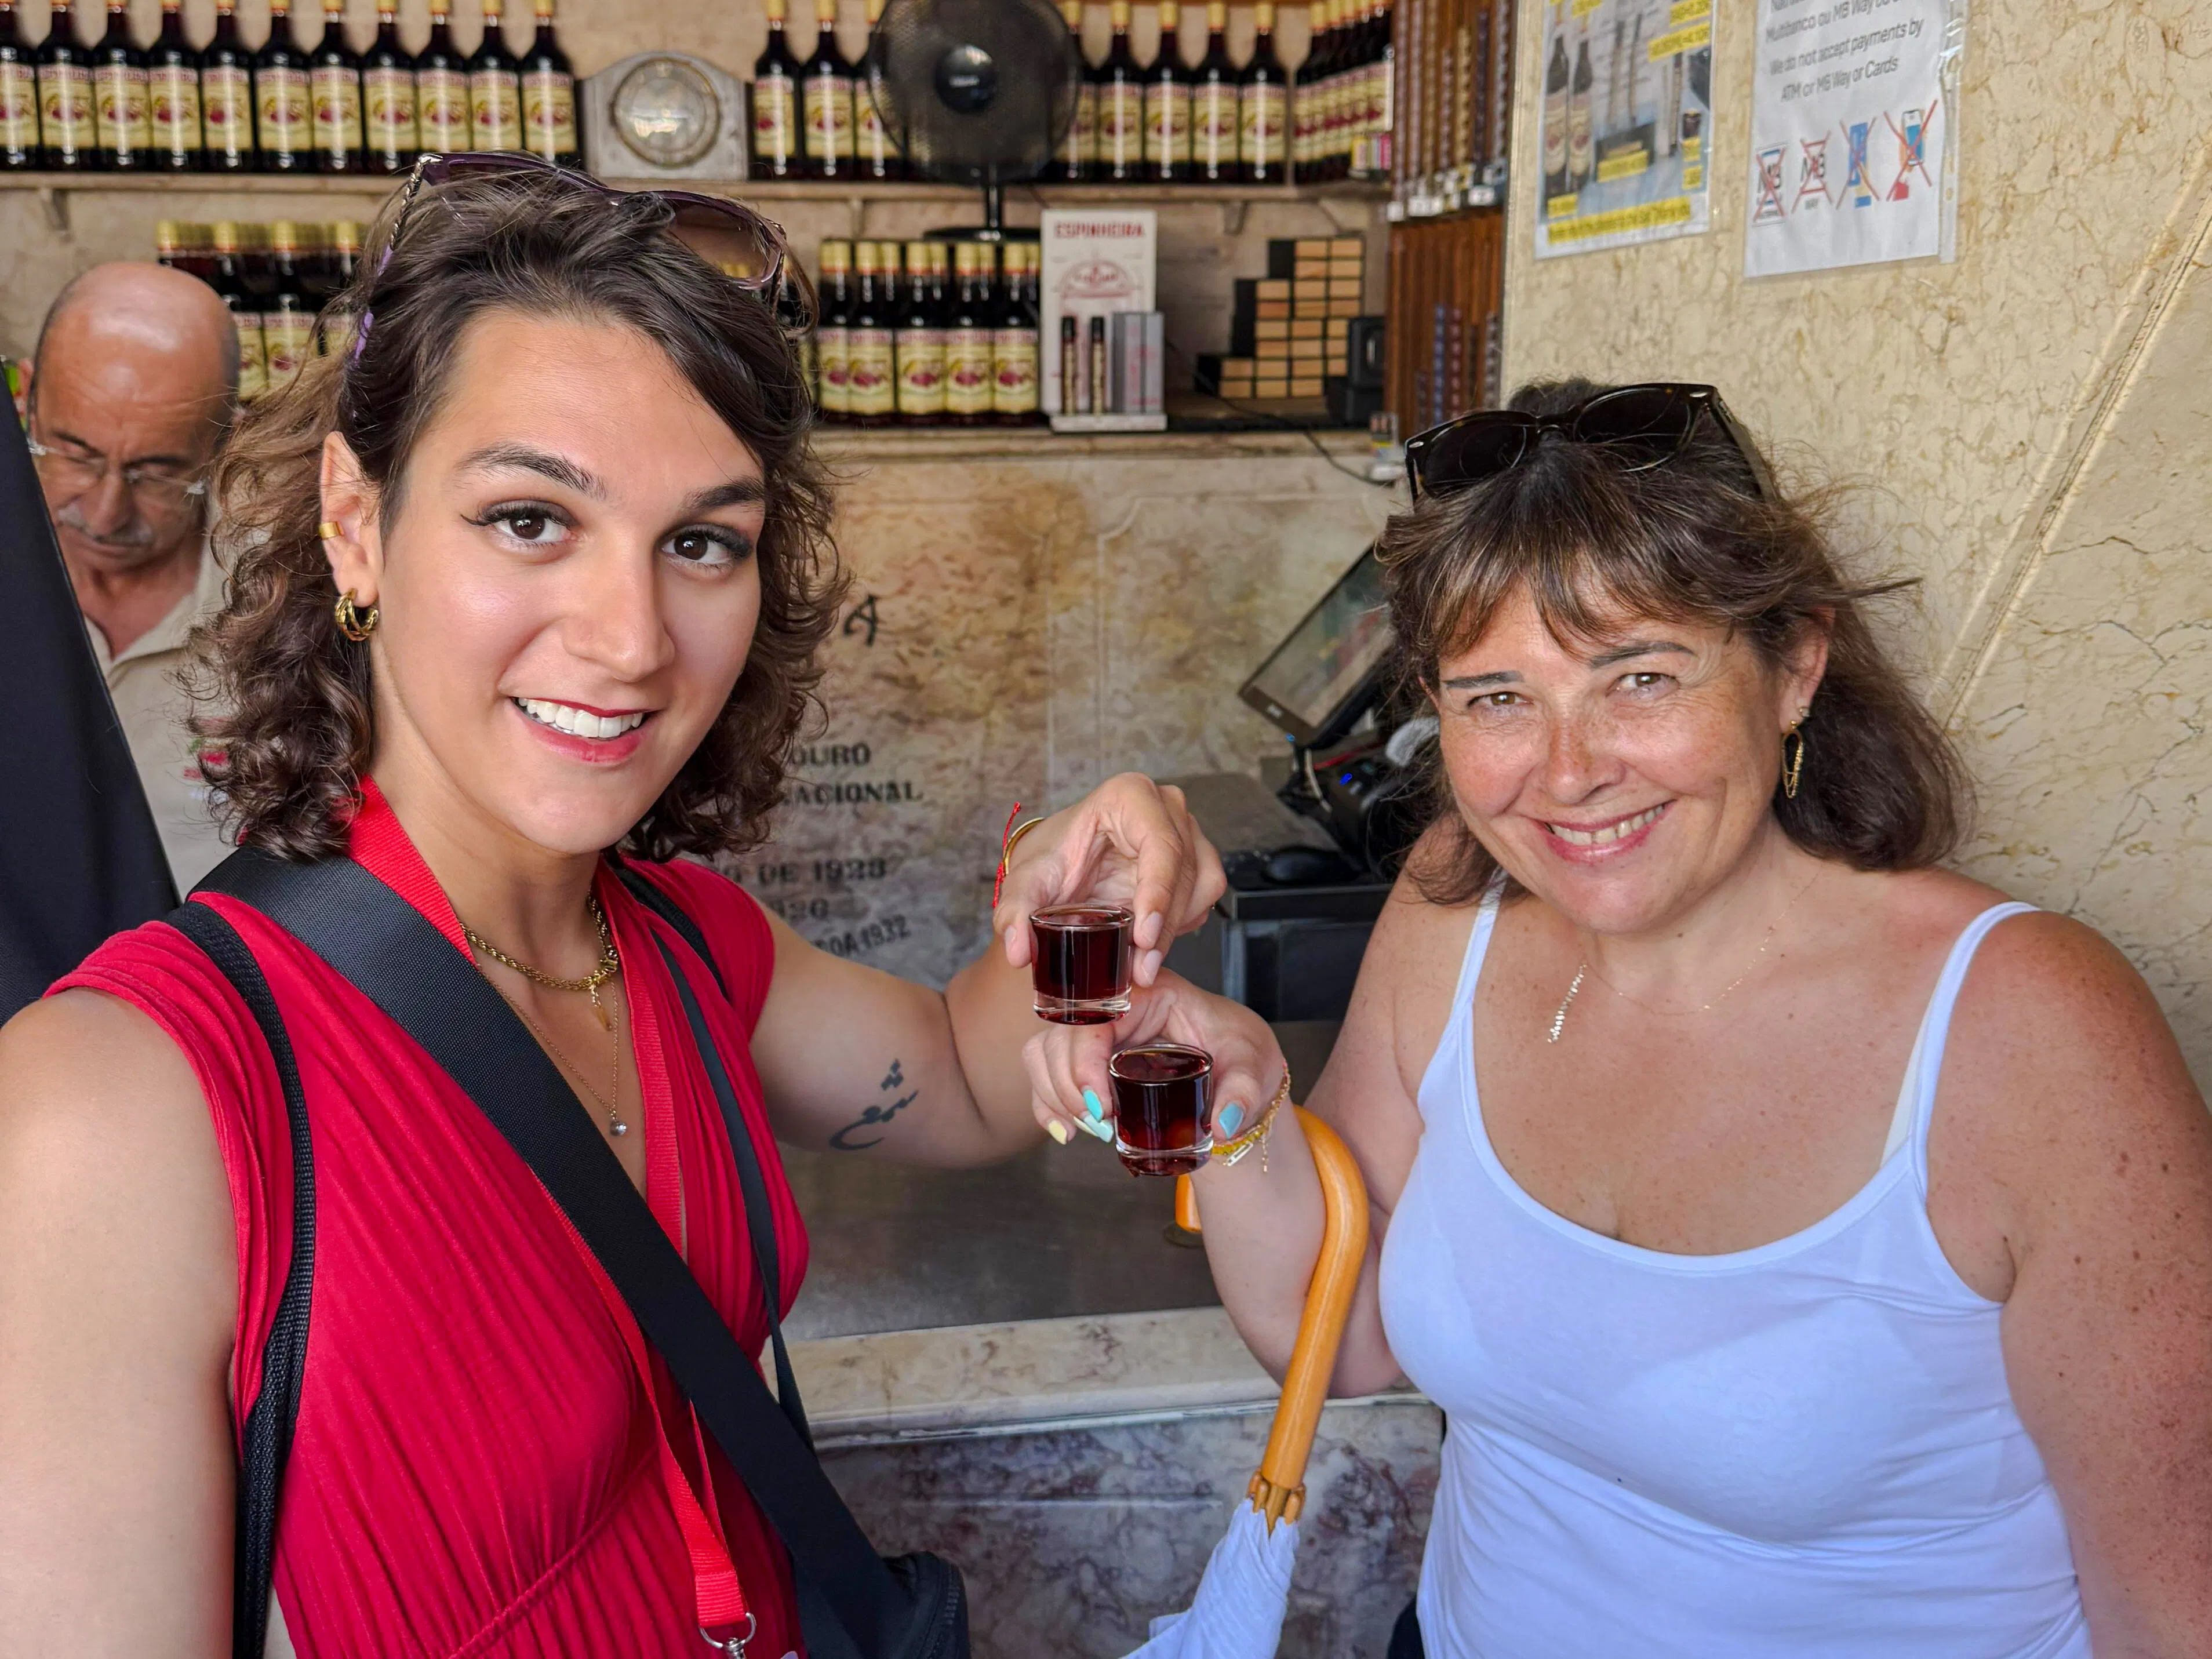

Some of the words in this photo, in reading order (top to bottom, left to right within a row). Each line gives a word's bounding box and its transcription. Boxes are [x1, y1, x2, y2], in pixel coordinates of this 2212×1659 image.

[1833, 1, 1849, 22] MB
[1784, 56, 1796, 71] do
[1798, 50, 1817, 67] not
[1818, 38, 1850, 63] accept
[1850, 23, 1908, 56] payments
[1908, 18, 1926, 38] by
[1781, 83, 1802, 102] ATM
[1802, 82, 1816, 97] or
[1817, 74, 1831, 92] MB
[1832, 70, 1851, 89] Way
[1852, 67, 1865, 82] or
[1865, 56, 1901, 79] Cards
